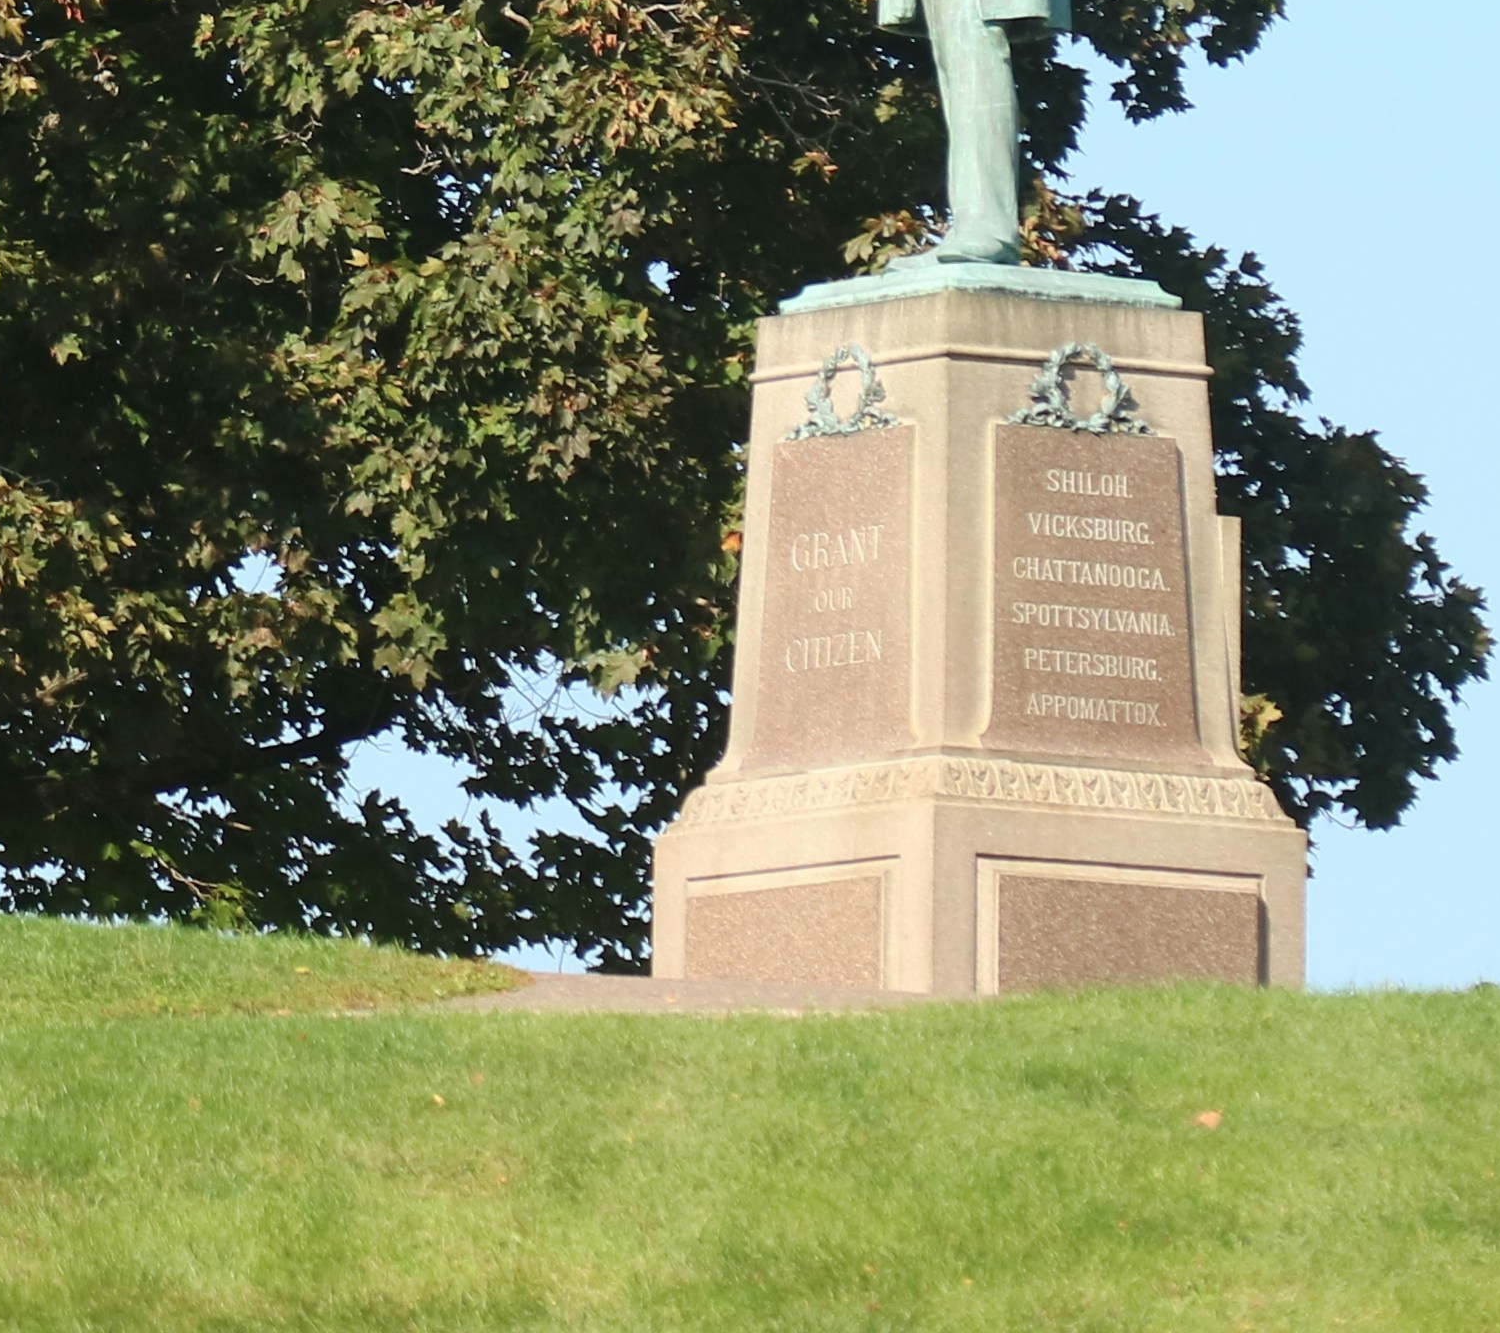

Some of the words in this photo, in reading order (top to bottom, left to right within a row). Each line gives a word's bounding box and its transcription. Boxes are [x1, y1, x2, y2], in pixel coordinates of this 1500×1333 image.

[1046, 469, 1134, 498] SHILOH.
[1027, 512, 1155, 546] VICKSBURG.
[790, 525, 885, 572] GRANT
[1013, 556, 1171, 592] CHATTANOOGA.
[814, 586, 854, 613] OUR
[1011, 602, 1176, 637] SPOTTSYLVANIA.
[786, 629, 882, 673] CITIZEN
[1024, 648, 1163, 681] PETERSBURG.
[1026, 692, 1168, 727] APPOMATTOX.
